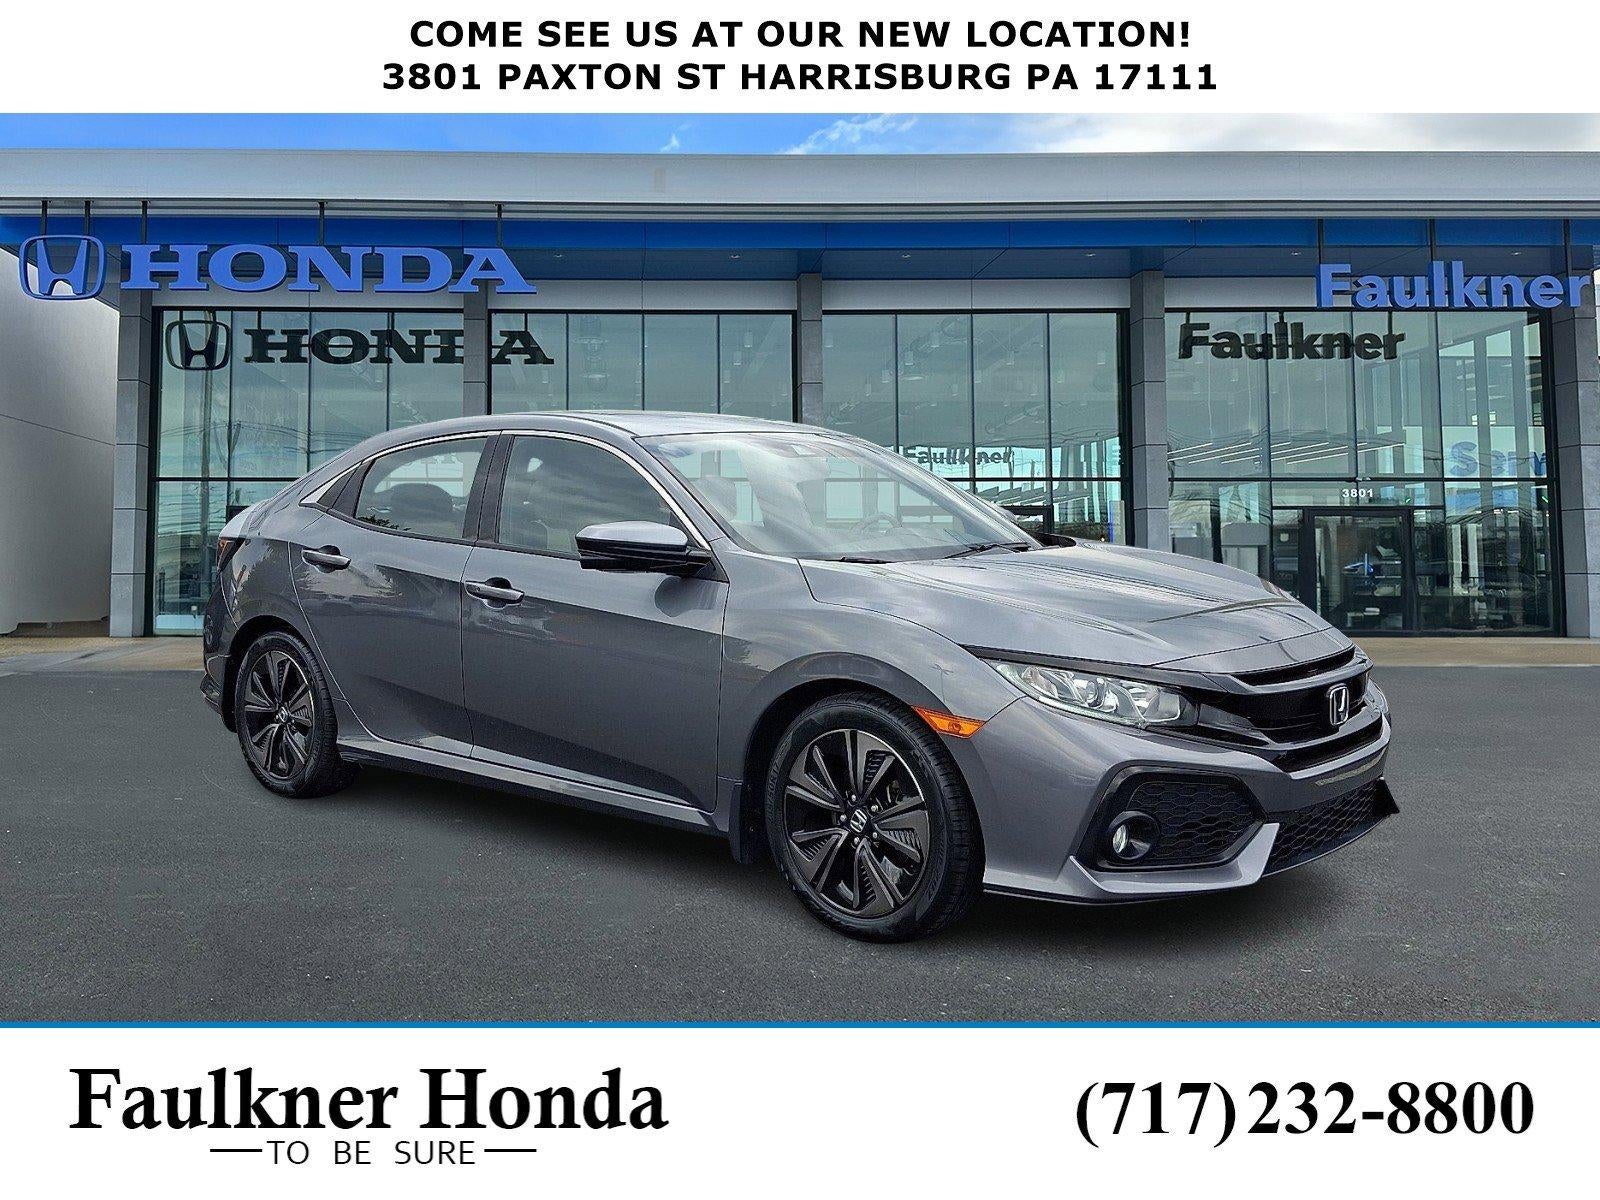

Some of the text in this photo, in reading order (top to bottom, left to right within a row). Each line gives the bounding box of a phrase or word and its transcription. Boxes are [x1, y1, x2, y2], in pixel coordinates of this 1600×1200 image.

[120, 243, 537, 294] HONDA
[1316, 260, 1590, 309] Faulkner
[1178, 322, 1405, 360] Faulkner
[1341, 488, 1374, 498] 3801
